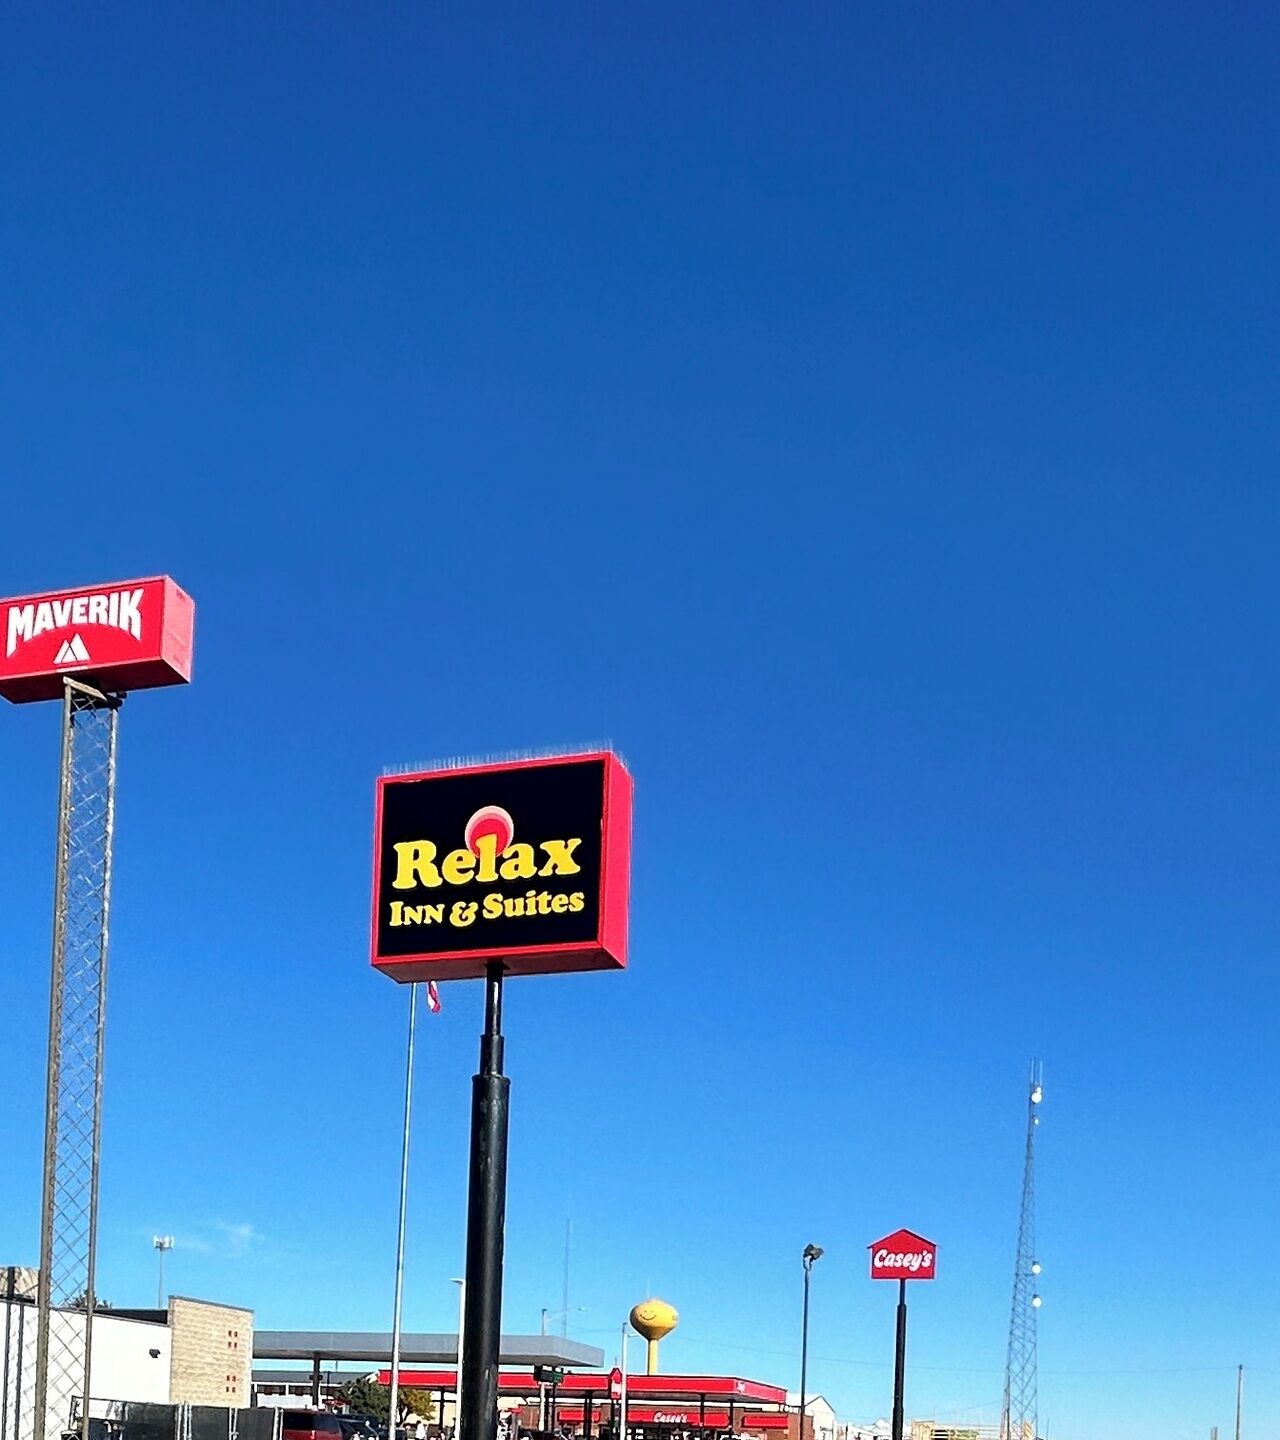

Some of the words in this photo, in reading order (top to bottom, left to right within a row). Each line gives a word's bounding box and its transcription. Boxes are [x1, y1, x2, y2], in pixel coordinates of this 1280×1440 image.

[6, 588, 144, 658] MAVERIK
[392, 833, 582, 889] Relax
[449, 901, 479, 927] &
[483, 890, 585, 919] Suites
[874, 1248, 933, 1272] Casey's
